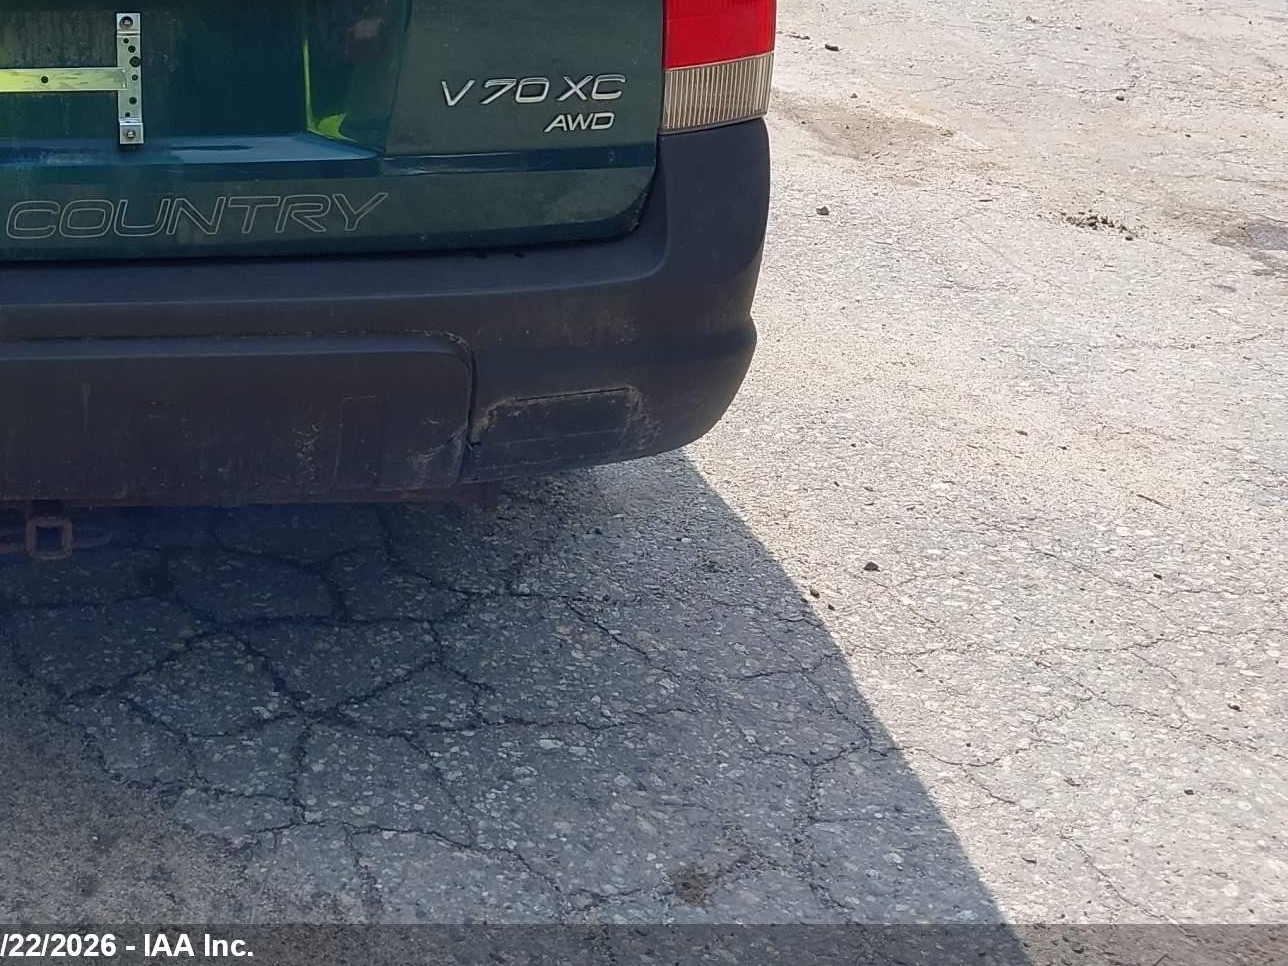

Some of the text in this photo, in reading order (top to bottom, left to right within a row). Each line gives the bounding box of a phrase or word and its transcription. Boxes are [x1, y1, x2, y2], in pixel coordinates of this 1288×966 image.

[556, 72, 626, 101] XC
[543, 111, 616, 132] AWD
[5, 192, 389, 240] COUNTRY
